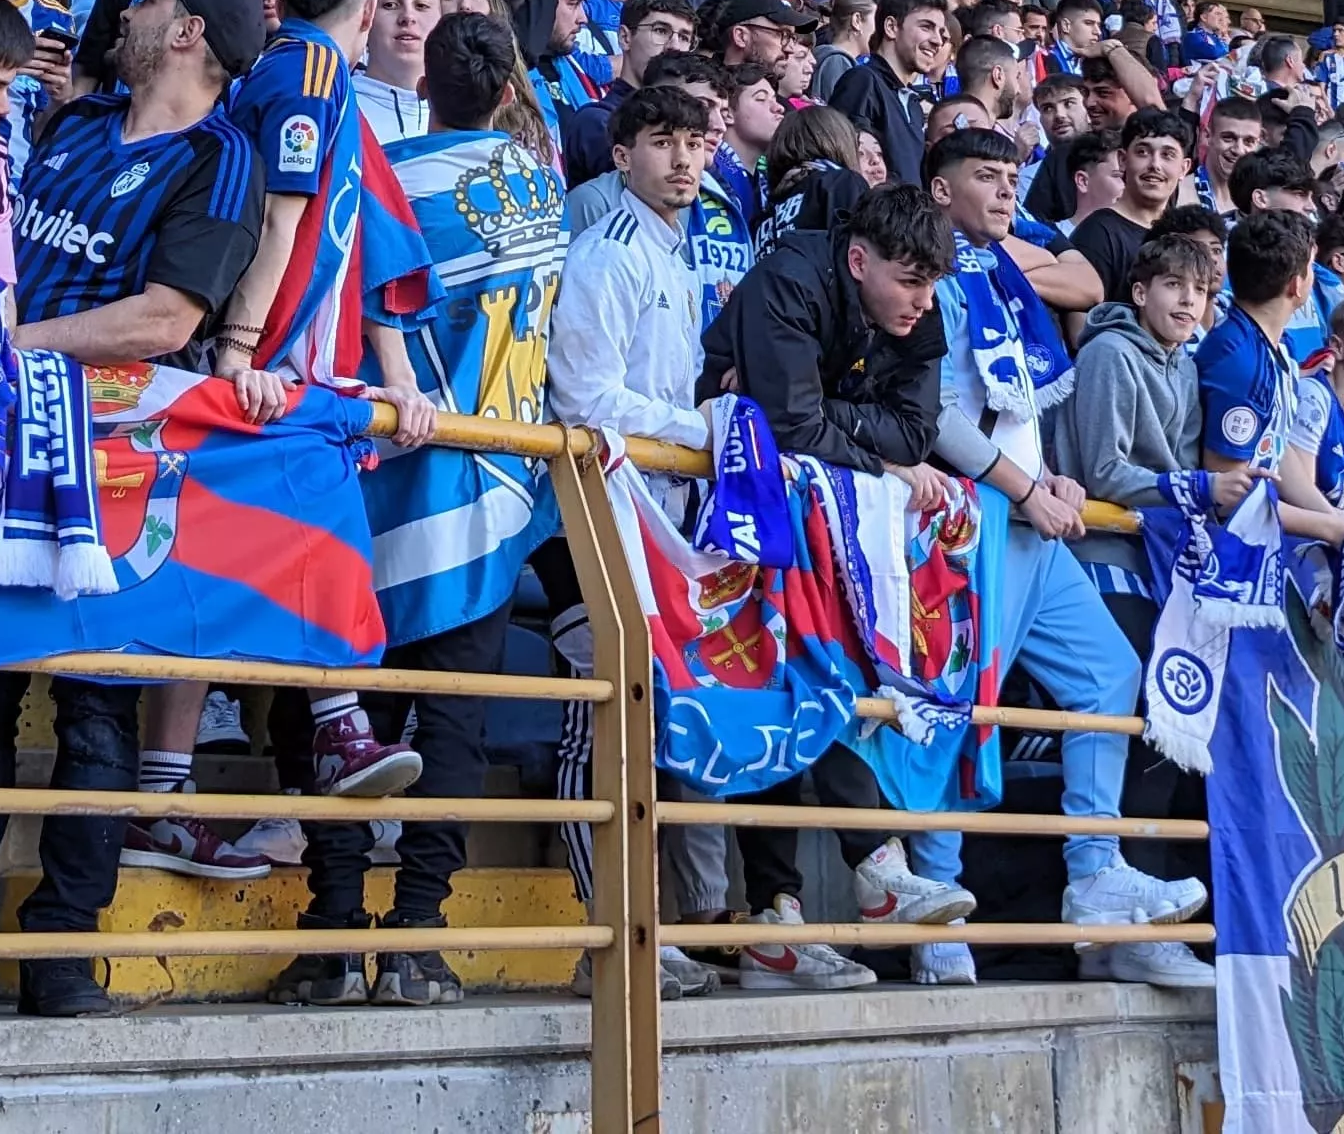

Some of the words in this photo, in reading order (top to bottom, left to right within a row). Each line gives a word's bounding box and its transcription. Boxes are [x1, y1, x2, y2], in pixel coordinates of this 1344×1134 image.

[281, 153, 313, 166] LaLiga
[23, 203, 115, 264] tvitec
[697, 239, 747, 273] 1922
